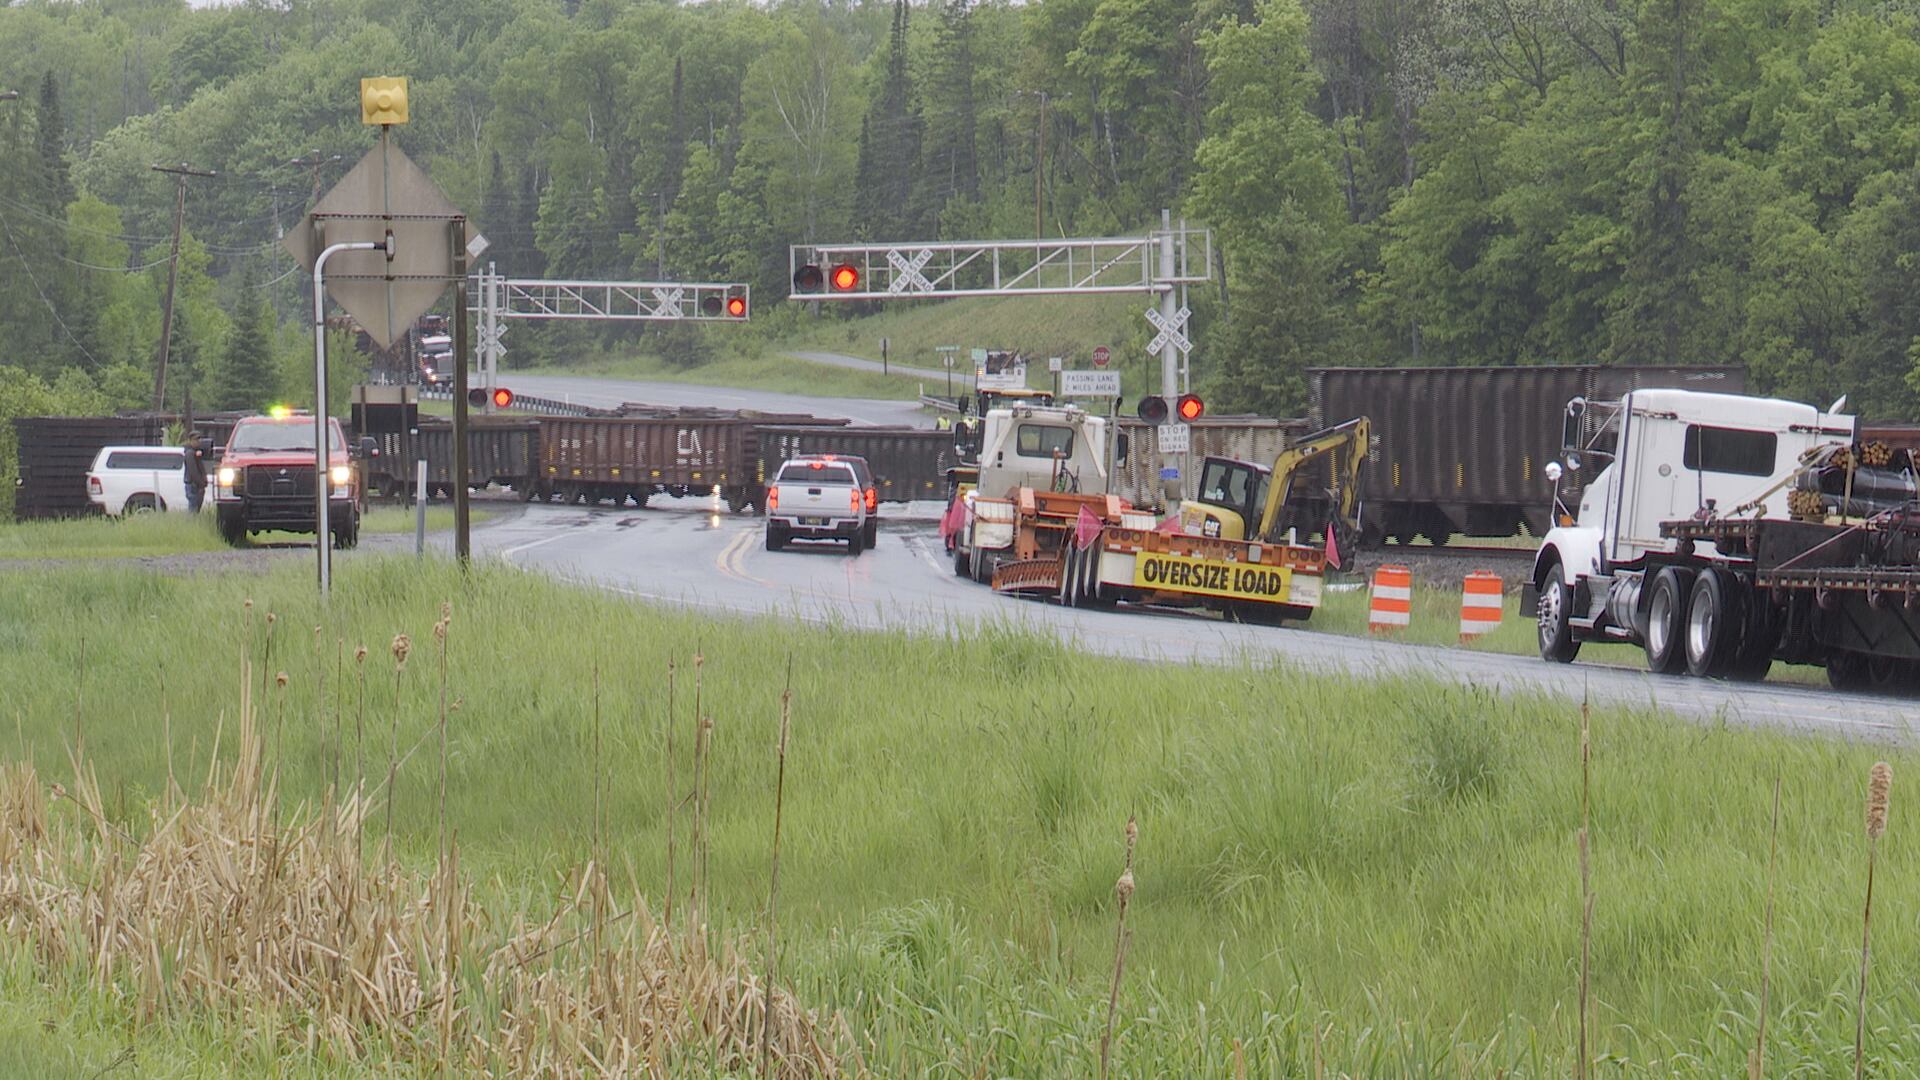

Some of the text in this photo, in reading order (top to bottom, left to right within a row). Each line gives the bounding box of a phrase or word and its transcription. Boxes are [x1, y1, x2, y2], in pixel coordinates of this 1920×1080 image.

[1146, 309, 1190, 351] RAIL ROAD
[1093, 352, 1109, 360] STOP
[1072, 384, 1091, 392] MILES
[1095, 384, 1117, 392] AHEAD
[1160, 426, 1186, 435] STOP
[1205, 520, 1220, 531] CAT
[1143, 558, 1230, 590] OVERSIZE
[1233, 568, 1281, 595] LOAD
